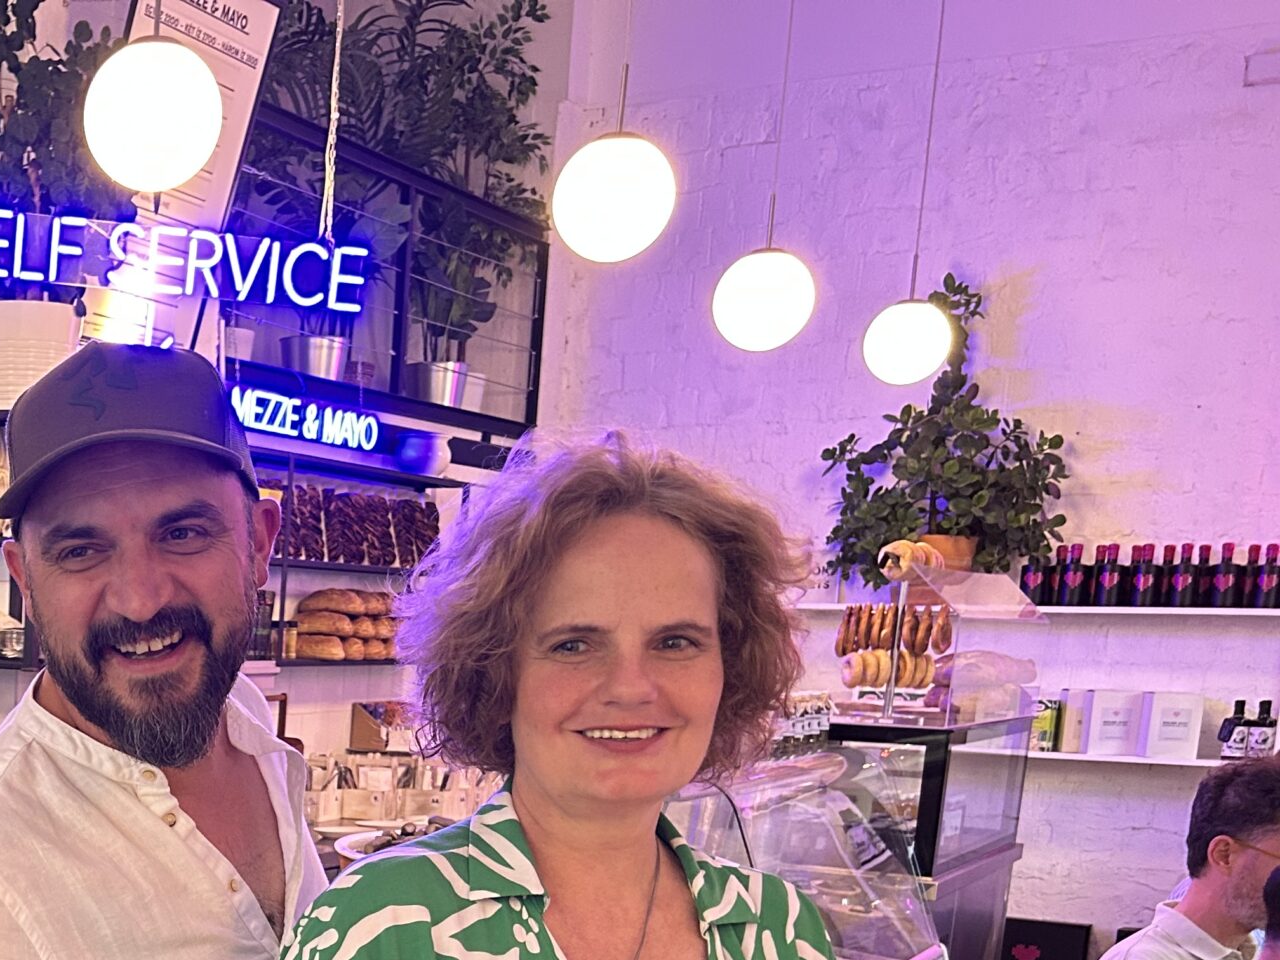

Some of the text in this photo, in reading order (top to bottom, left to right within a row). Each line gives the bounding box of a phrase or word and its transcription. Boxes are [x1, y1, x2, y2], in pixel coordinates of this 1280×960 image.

[220, 4, 248, 30] MAYO
[106, 222, 369, 313] SERVICE
[231, 385, 379, 451] MEZZE & MAYO
